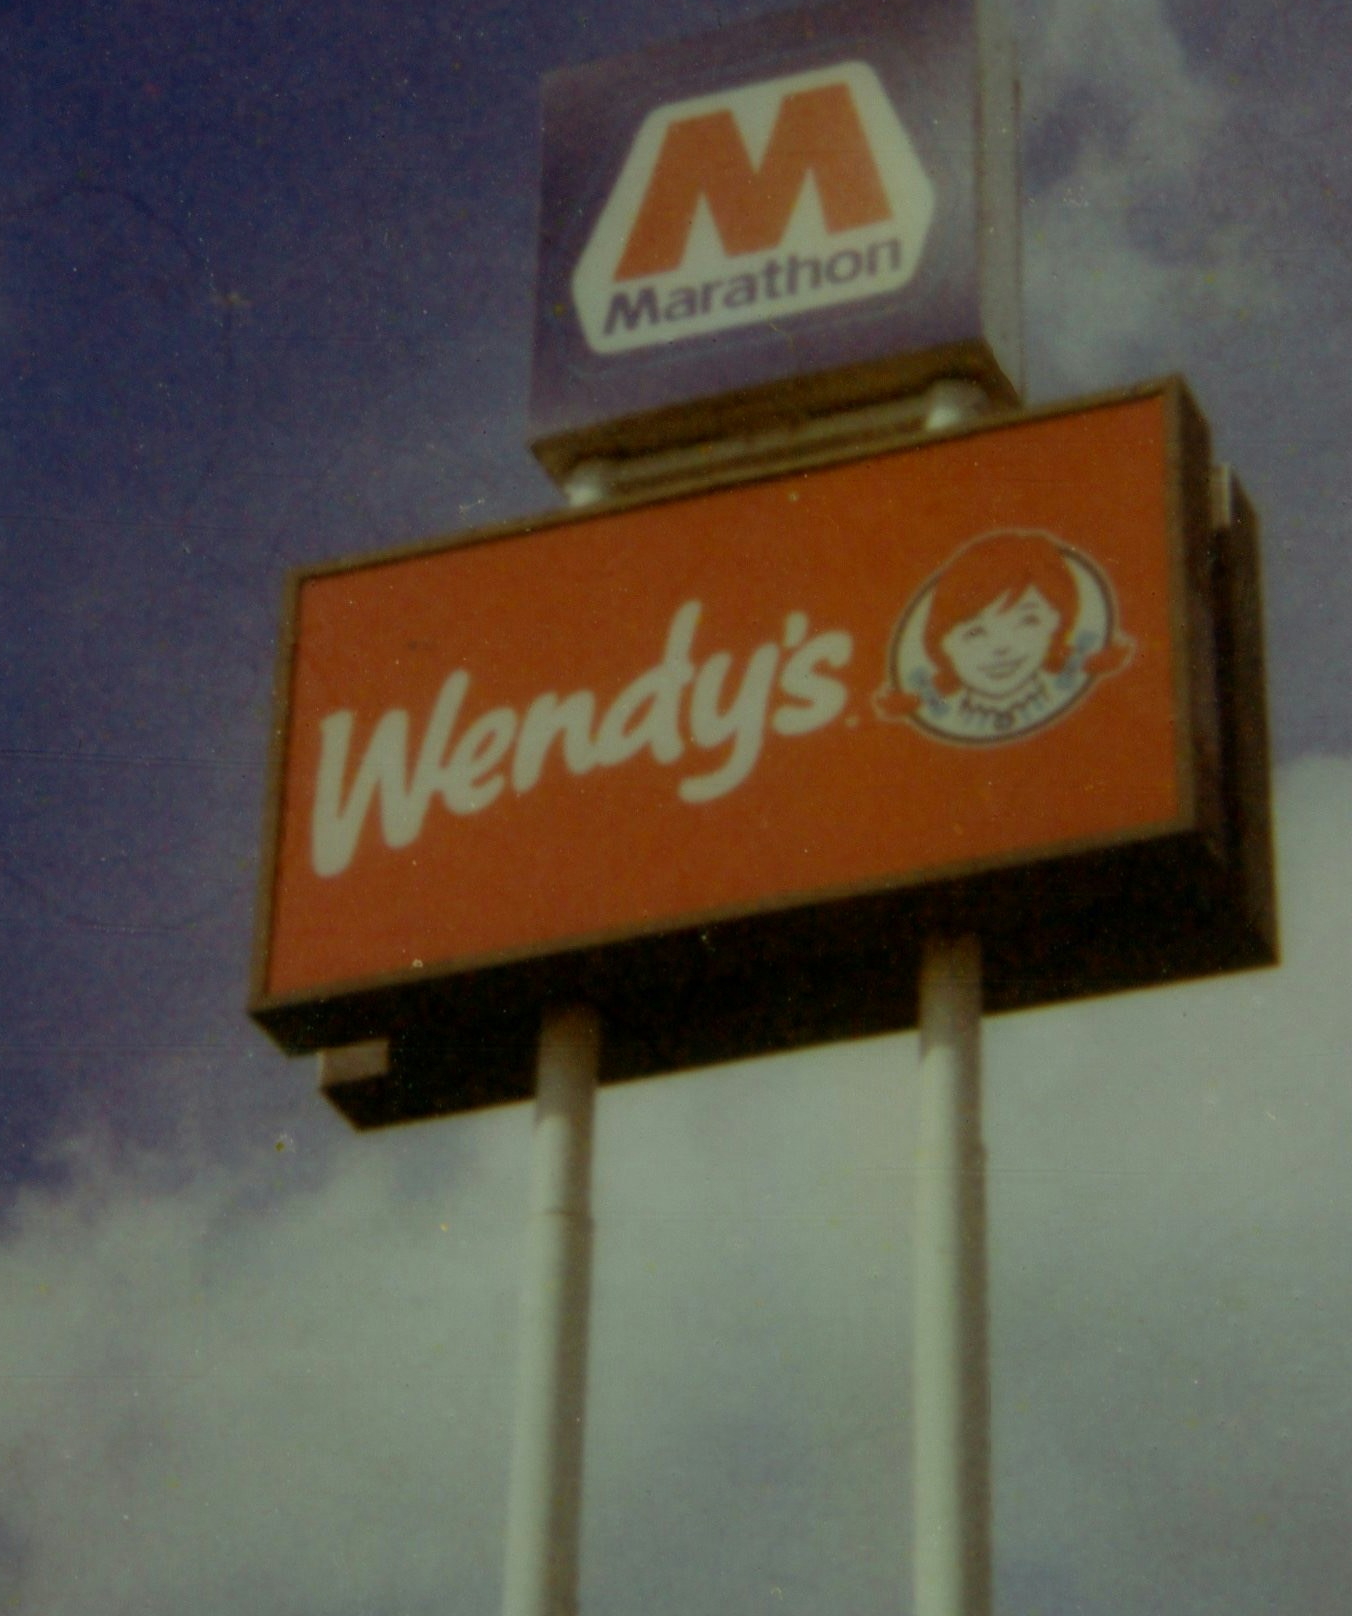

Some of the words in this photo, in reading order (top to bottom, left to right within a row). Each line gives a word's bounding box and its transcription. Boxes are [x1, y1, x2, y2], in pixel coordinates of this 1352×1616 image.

[614, 82, 894, 283] M
[601, 237, 902, 337] Marathon
[311, 599, 854, 878] Wendy's
